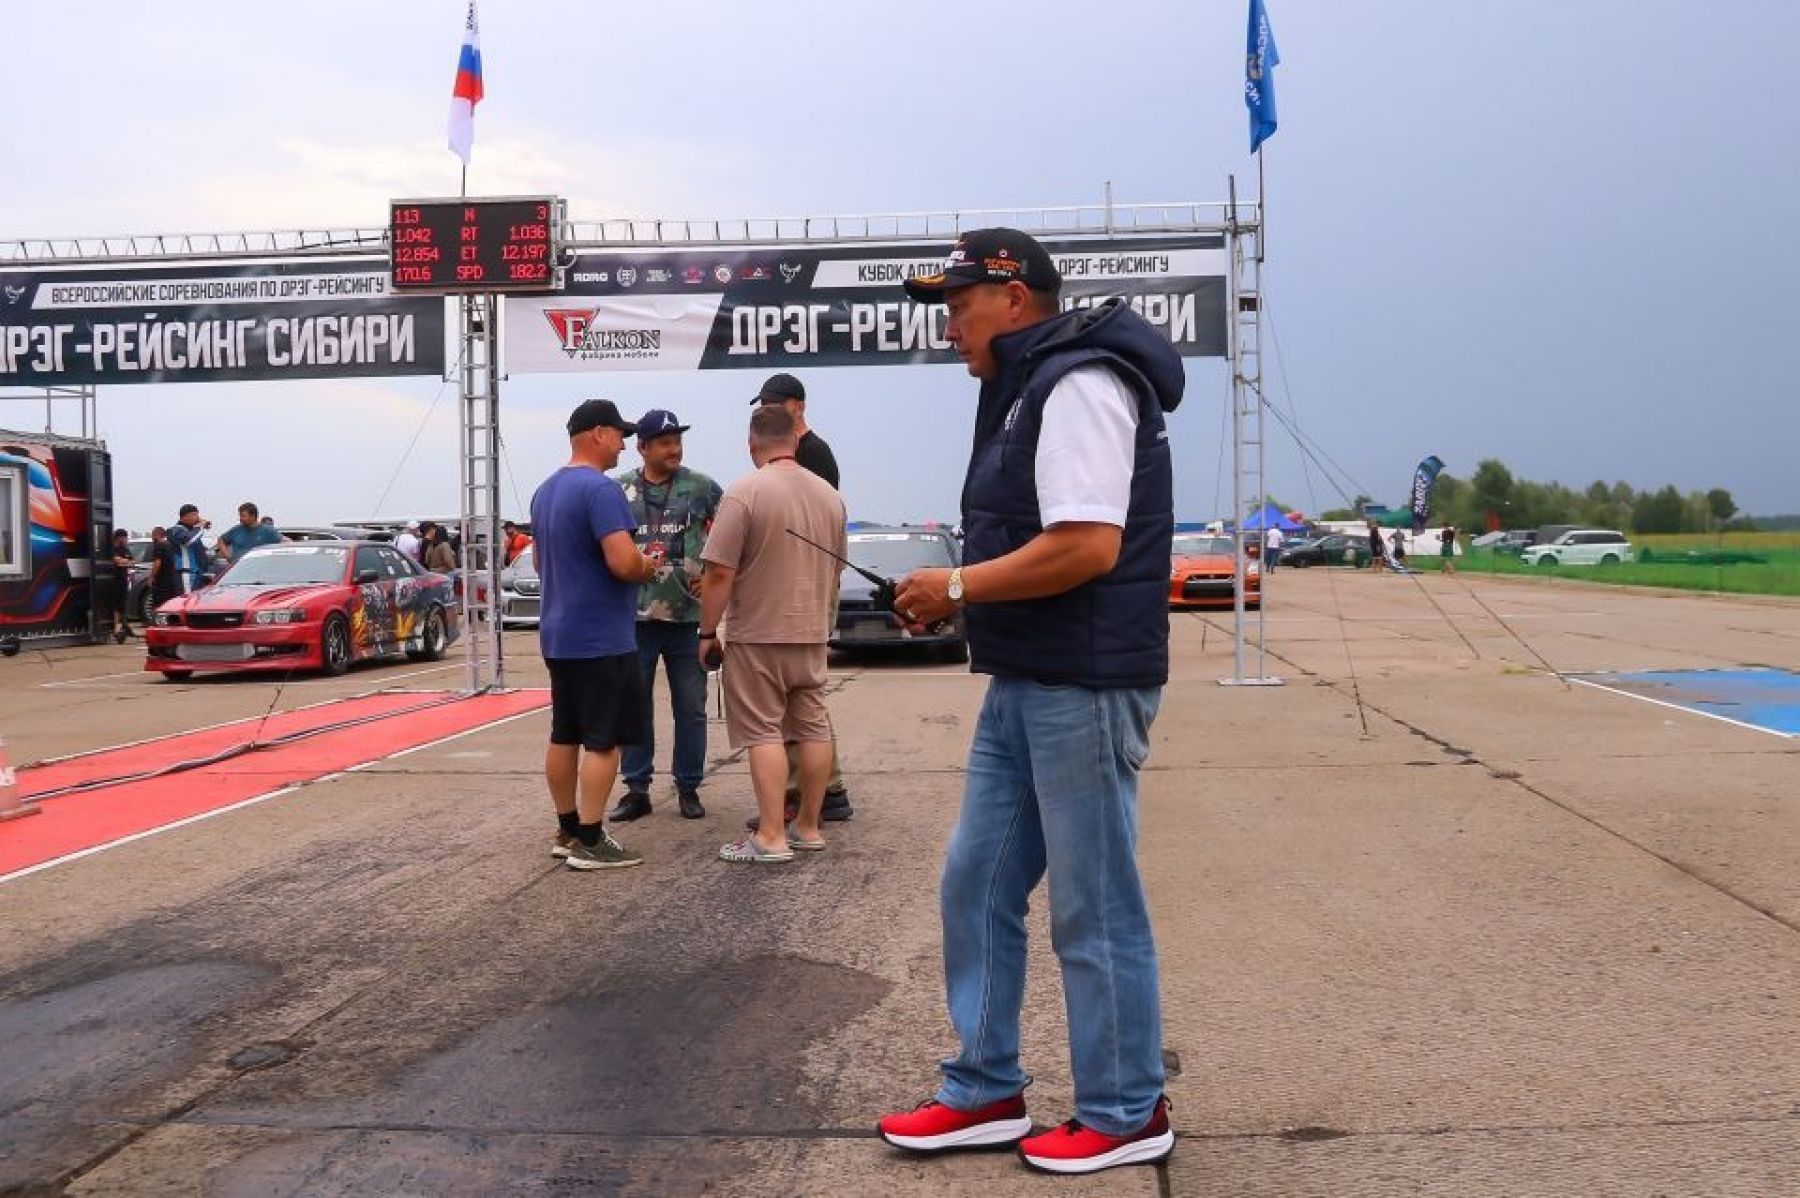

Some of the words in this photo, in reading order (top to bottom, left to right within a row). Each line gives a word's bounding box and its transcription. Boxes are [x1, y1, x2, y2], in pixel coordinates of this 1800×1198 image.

[394, 208, 419, 224] 113
[537, 205, 547, 220] 3
[395, 228, 432, 243] 1.042
[460, 227, 479, 241] RT
[509, 225, 547, 240] 1.036
[395, 247, 440, 262] 12.854
[461, 246, 479, 260] ET
[502, 244, 547, 260] 12.197
[395, 267, 432, 282] 170.6
[456, 266, 484, 280] SPD
[509, 264, 547, 279] 182.2
[858, 263, 902, 282] КУБОК
[1058, 255, 1169, 275] ДРЭГ-РЕЙСИНГУ
[52, 283, 157, 304] ВСЕРОССИЙСКИЕ
[159, 281, 257, 300] СОРЕВНОВАНИЯ
[260, 281, 277, 298] ПО
[279, 275, 385, 297] ДРЭГ-РЕЙСИНГУ
[564, 316, 661, 351] FALKON
[727, 302, 957, 356] ДРЭГ-РЕЙС
[0, 313, 256, 374] РЭГ-РЕЙСИНГ
[266, 314, 415, 368] СИБИРИ
